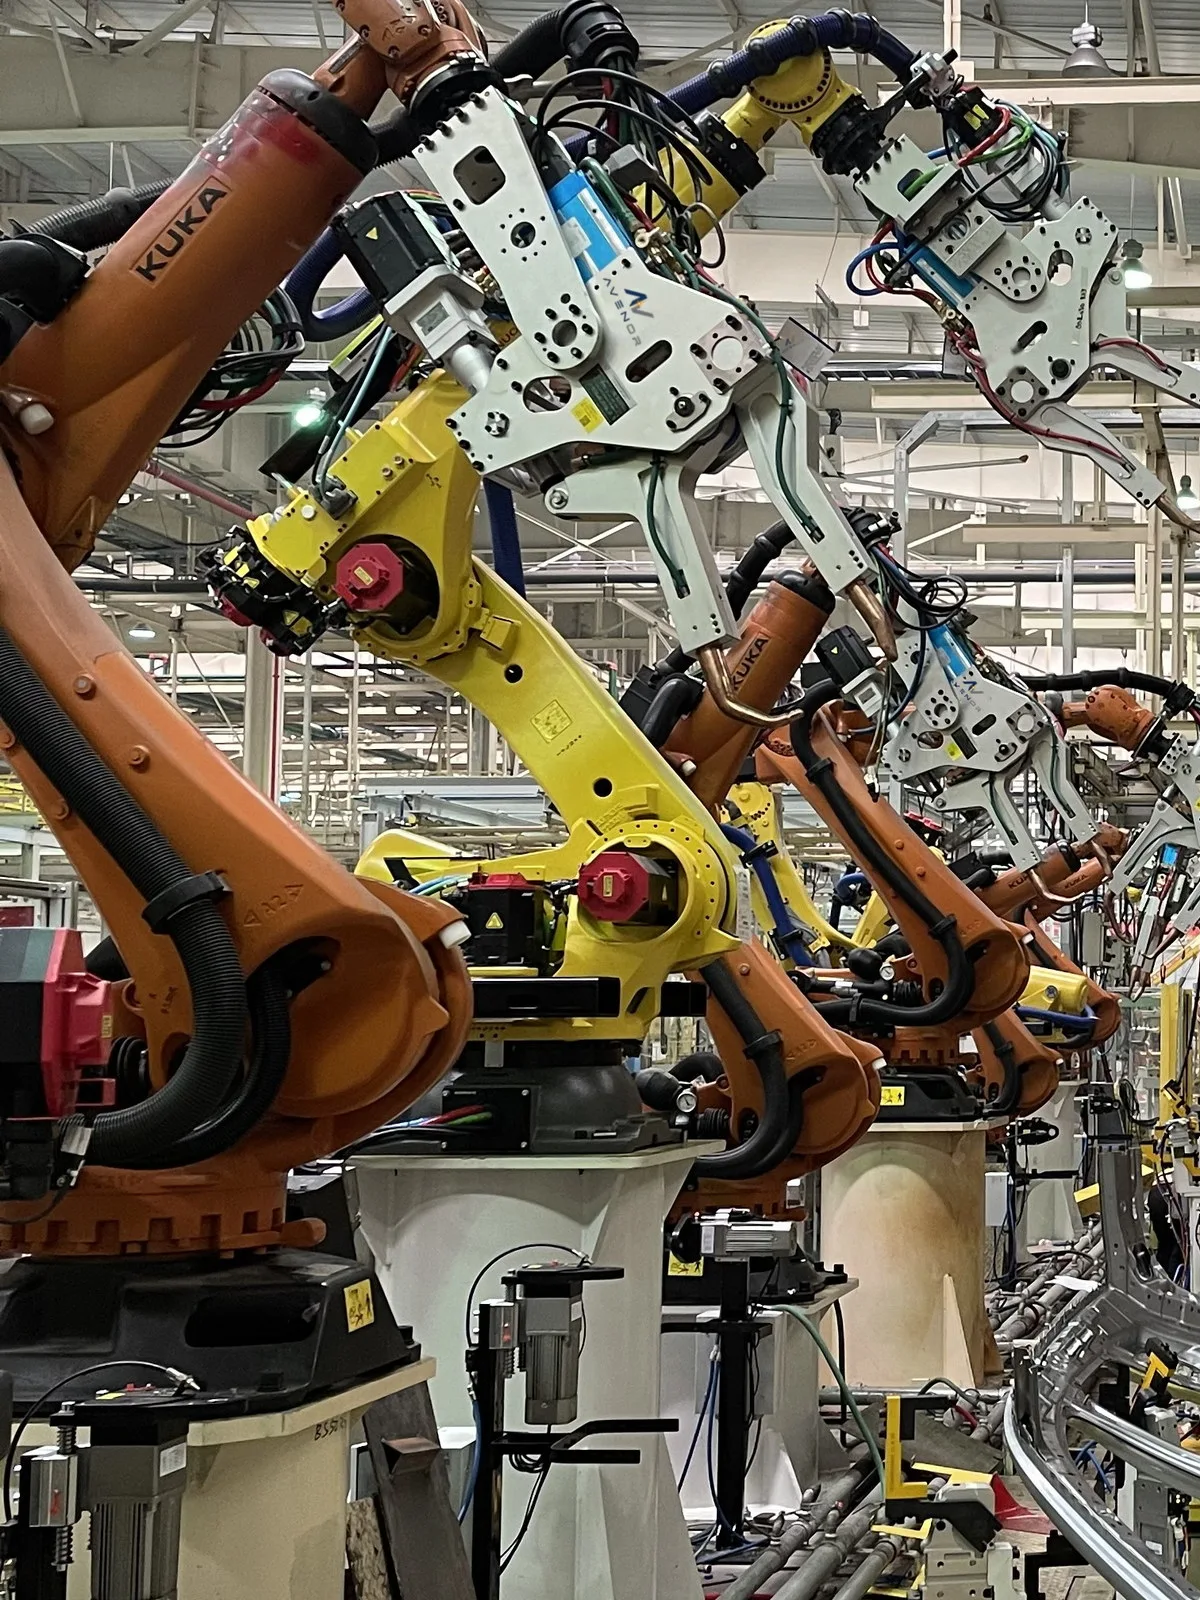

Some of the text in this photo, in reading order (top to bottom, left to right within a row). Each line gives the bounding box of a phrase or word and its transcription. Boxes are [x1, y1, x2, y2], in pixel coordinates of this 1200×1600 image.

[135, 187, 228, 283] KUKA
[602, 277, 643, 347] AVENOR
[732, 638, 769, 691] KUKA
